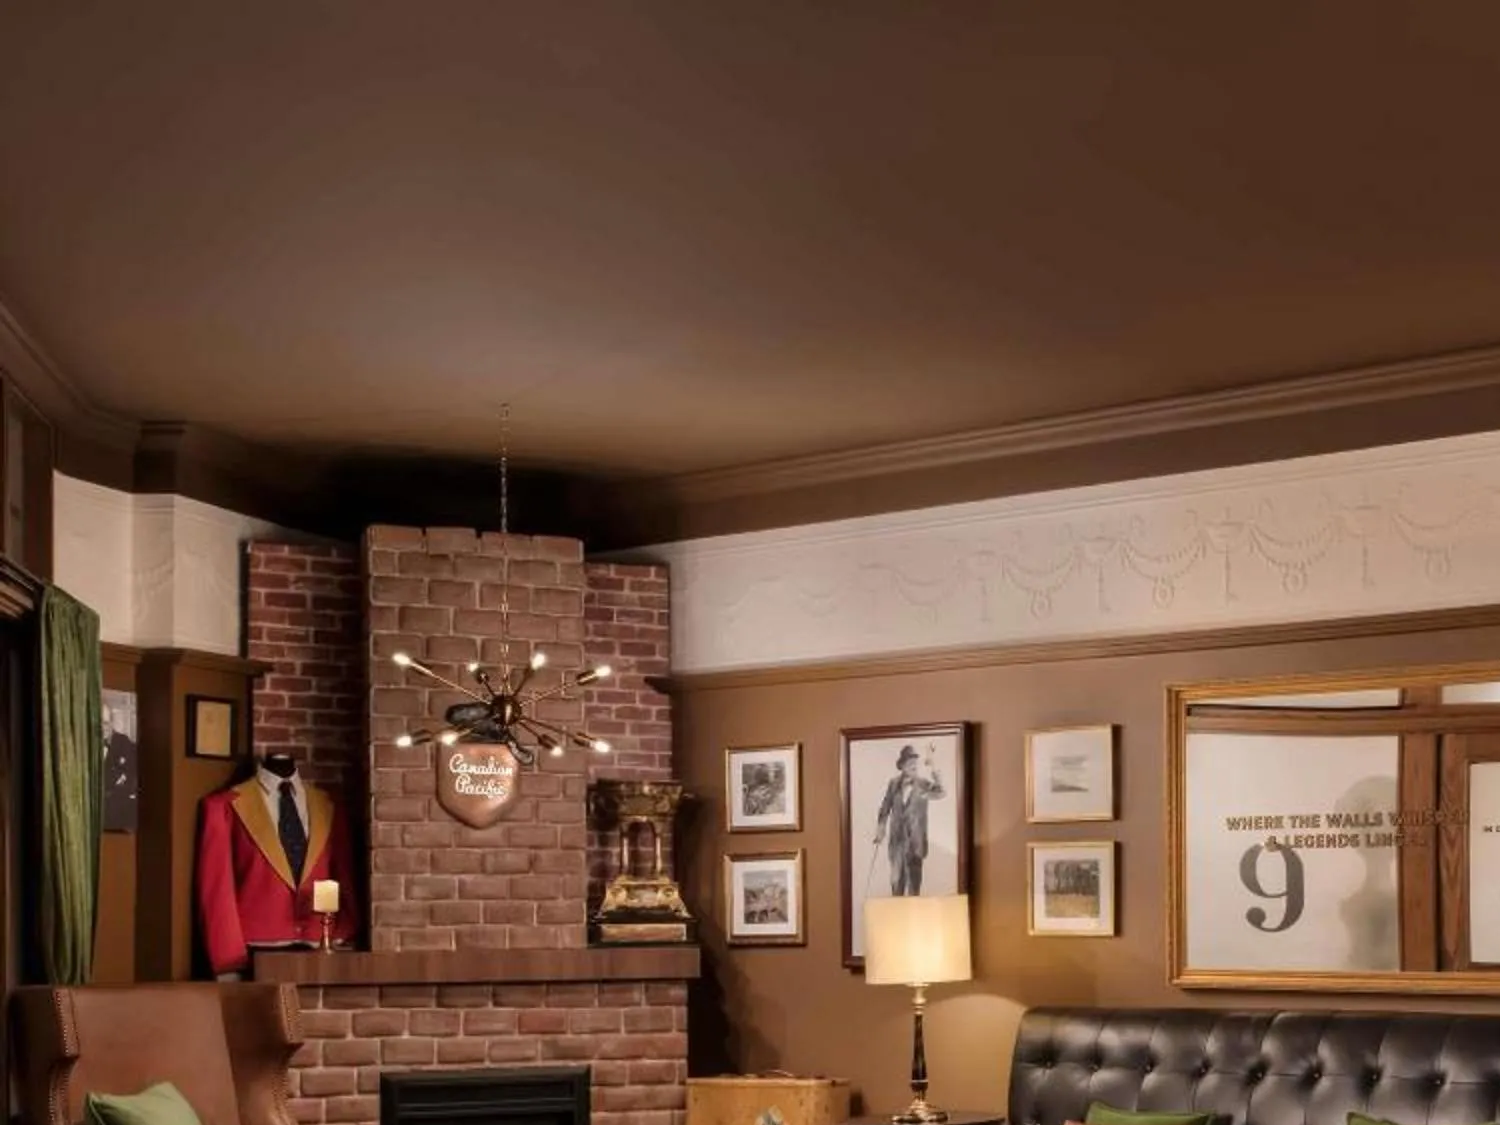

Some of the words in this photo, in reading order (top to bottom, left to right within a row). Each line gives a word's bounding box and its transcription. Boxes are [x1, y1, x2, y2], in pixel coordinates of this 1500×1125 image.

[449, 753, 513, 776] Canadian
[455, 773, 507, 799] Pacific
[1226, 815, 1285, 831] WHERE
[1288, 814, 1320, 829] THE
[1325, 811, 1383, 828] WALLS
[1285, 833, 1360, 850] LEGENDS
[1239, 843, 1305, 933] 9
